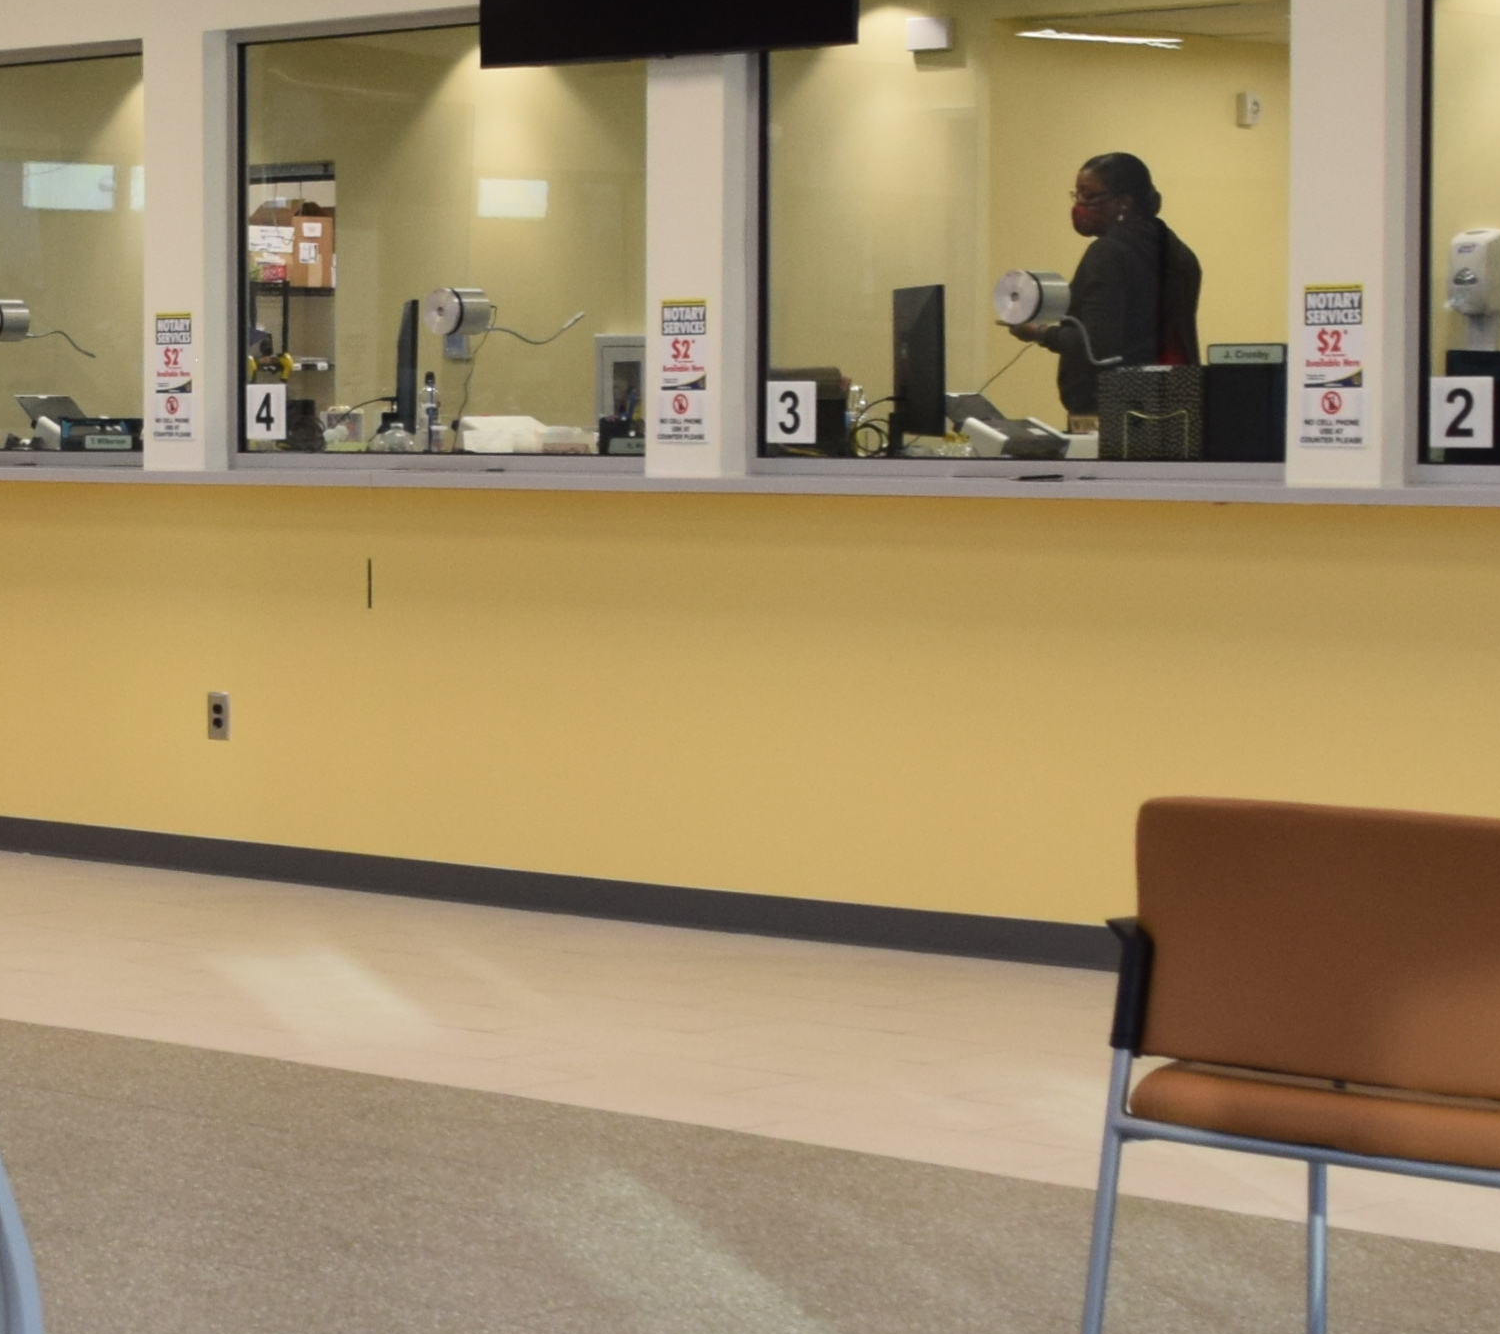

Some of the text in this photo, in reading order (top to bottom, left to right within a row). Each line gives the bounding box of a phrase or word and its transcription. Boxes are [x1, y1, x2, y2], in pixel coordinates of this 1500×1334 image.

[1307, 292, 1361, 309] NOTARY
[663, 307, 705, 321] NOTARY
[1306, 310, 1361, 325] SERVICES
[157, 319, 191, 332] NOTARY
[663, 321, 705, 335] SERVICES
[157, 332, 191, 344] SERVICES
[1305, 359, 1361, 367] Available Here
[255, 392, 275, 432] 4
[778, 390, 801, 435] 3
[1445, 388, 1474, 438] 2
[1304, 419, 1360, 427] NO CELL PHONE
[1300, 436, 1362, 444] COUNTER PLEASE
